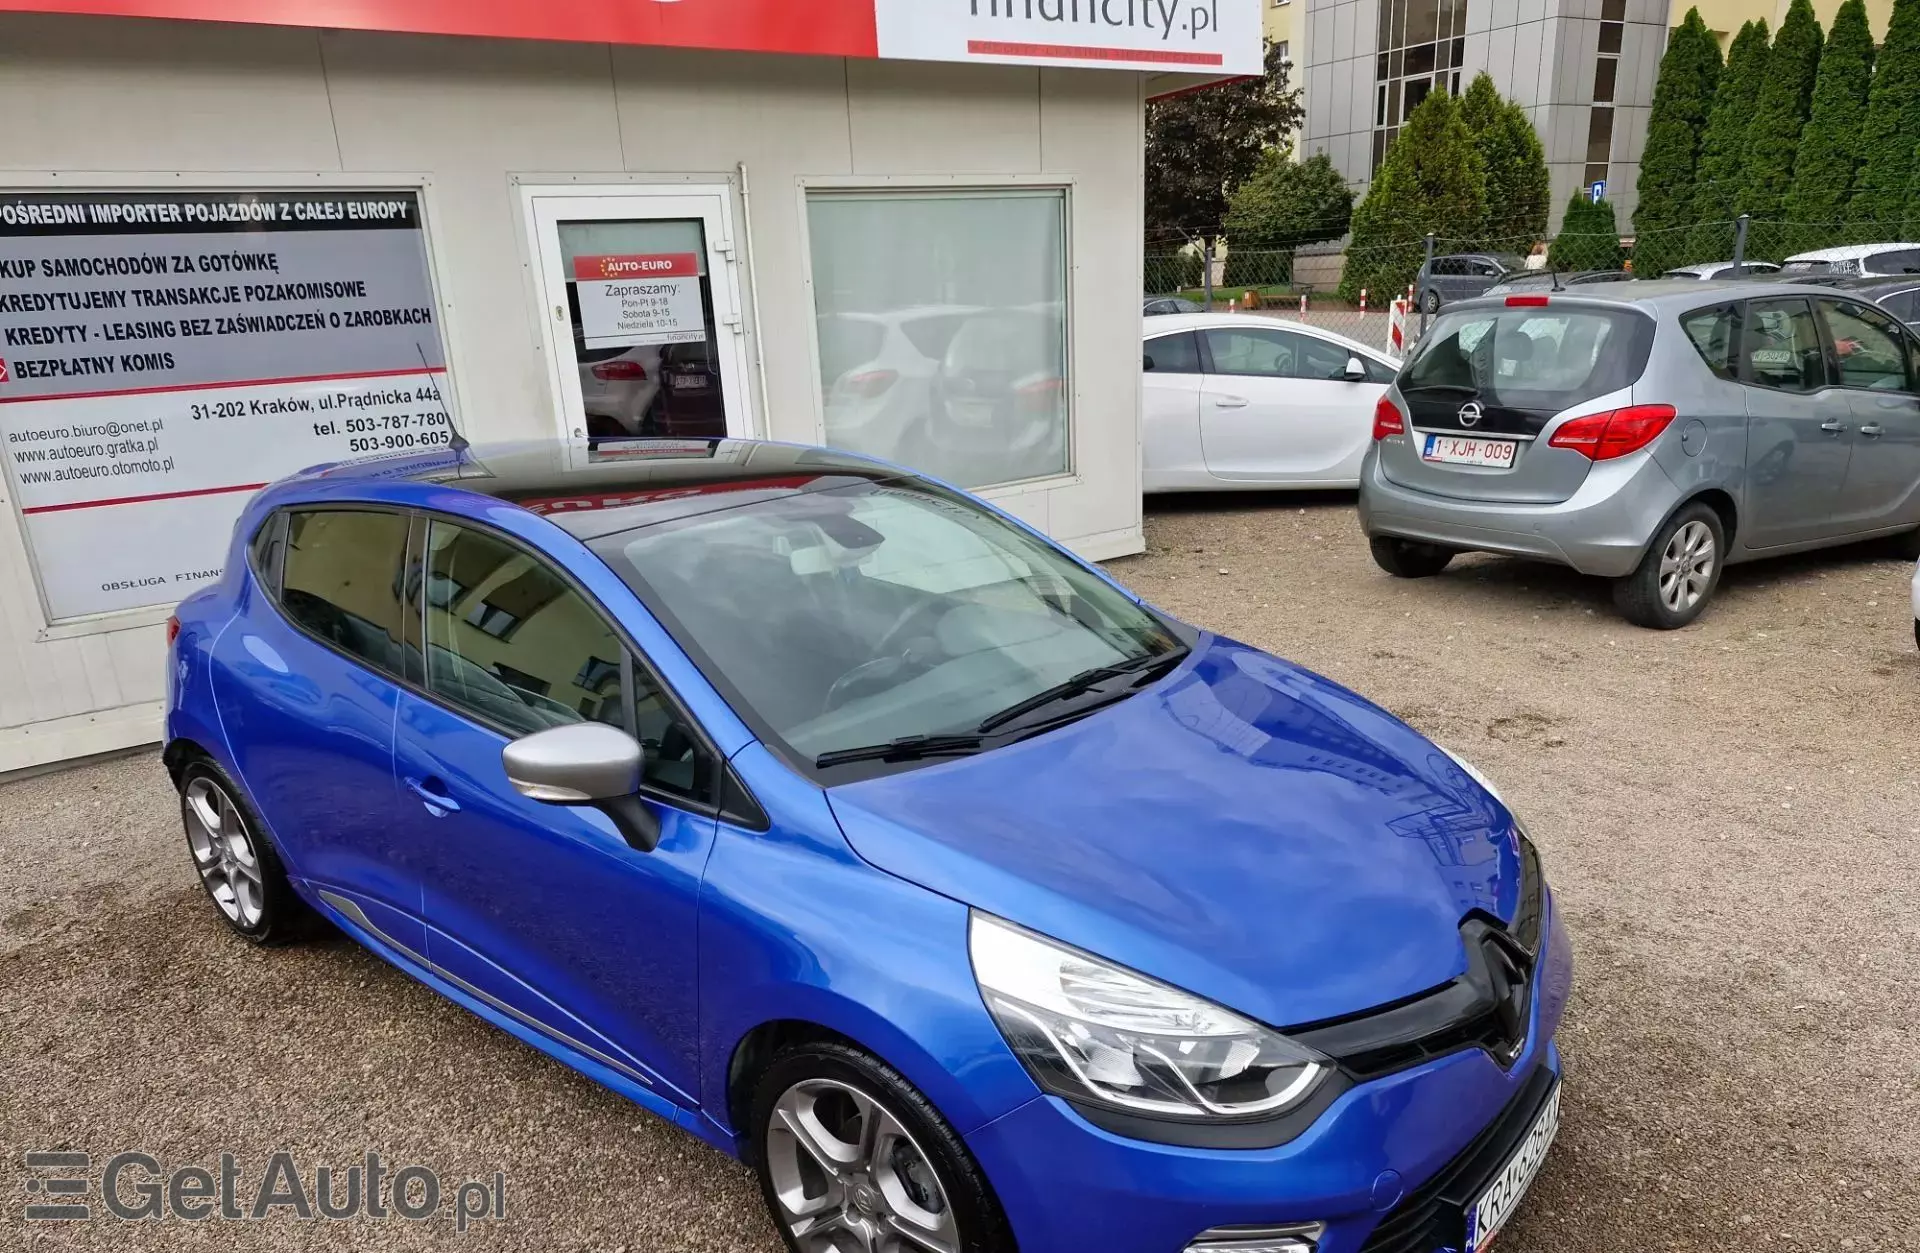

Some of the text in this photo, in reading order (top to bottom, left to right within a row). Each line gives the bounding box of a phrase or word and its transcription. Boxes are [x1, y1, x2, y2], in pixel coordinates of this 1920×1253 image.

[90, 203, 182, 224] IMPORTER
[185, 199, 276, 222] POJAZDÓW
[280, 202, 292, 221] Z
[294, 201, 344, 220] CAŁEJ
[348, 201, 407, 219] EUROPY
[41, 252, 167, 277] SAMOCHODÓW
[171, 255, 196, 274] ZA
[199, 250, 280, 275] GOTÓWKĘ
[607, 260, 672, 272] AUTO-EURO
[0, 280, 367, 313] KREDYTUJEMY TRANSAKCJE POZAKOMISOWE
[605, 283, 681, 298] Zapraszamy:
[622, 308, 670, 319] Sobota 9-15
[4, 325, 87, 346] KREDYTY
[103, 320, 176, 341] LEASING
[180, 318, 213, 337] BEZ
[215, 308, 326, 335] ZAŚWIADCZEŃ
[329, 311, 340, 328] O
[344, 307, 432, 328] ZAROBKACH
[14, 352, 175, 379] BEZPŁATNY KOMIS
[191, 387, 441, 420] 31-202 Kraków, ul.Prądnicka 44a
[9, 418, 164, 443] autoeuro.biuro@onet.pl
[313, 412, 445, 437] tel. 503-787-780
[14, 437, 159, 463] www.autoeuro.gratka.pl
[350, 430, 449, 453] 503-900-605
[20, 456, 175, 484] www.autoeuro.otomoto.pl
[102, 576, 167, 592] OBSŁUGA
